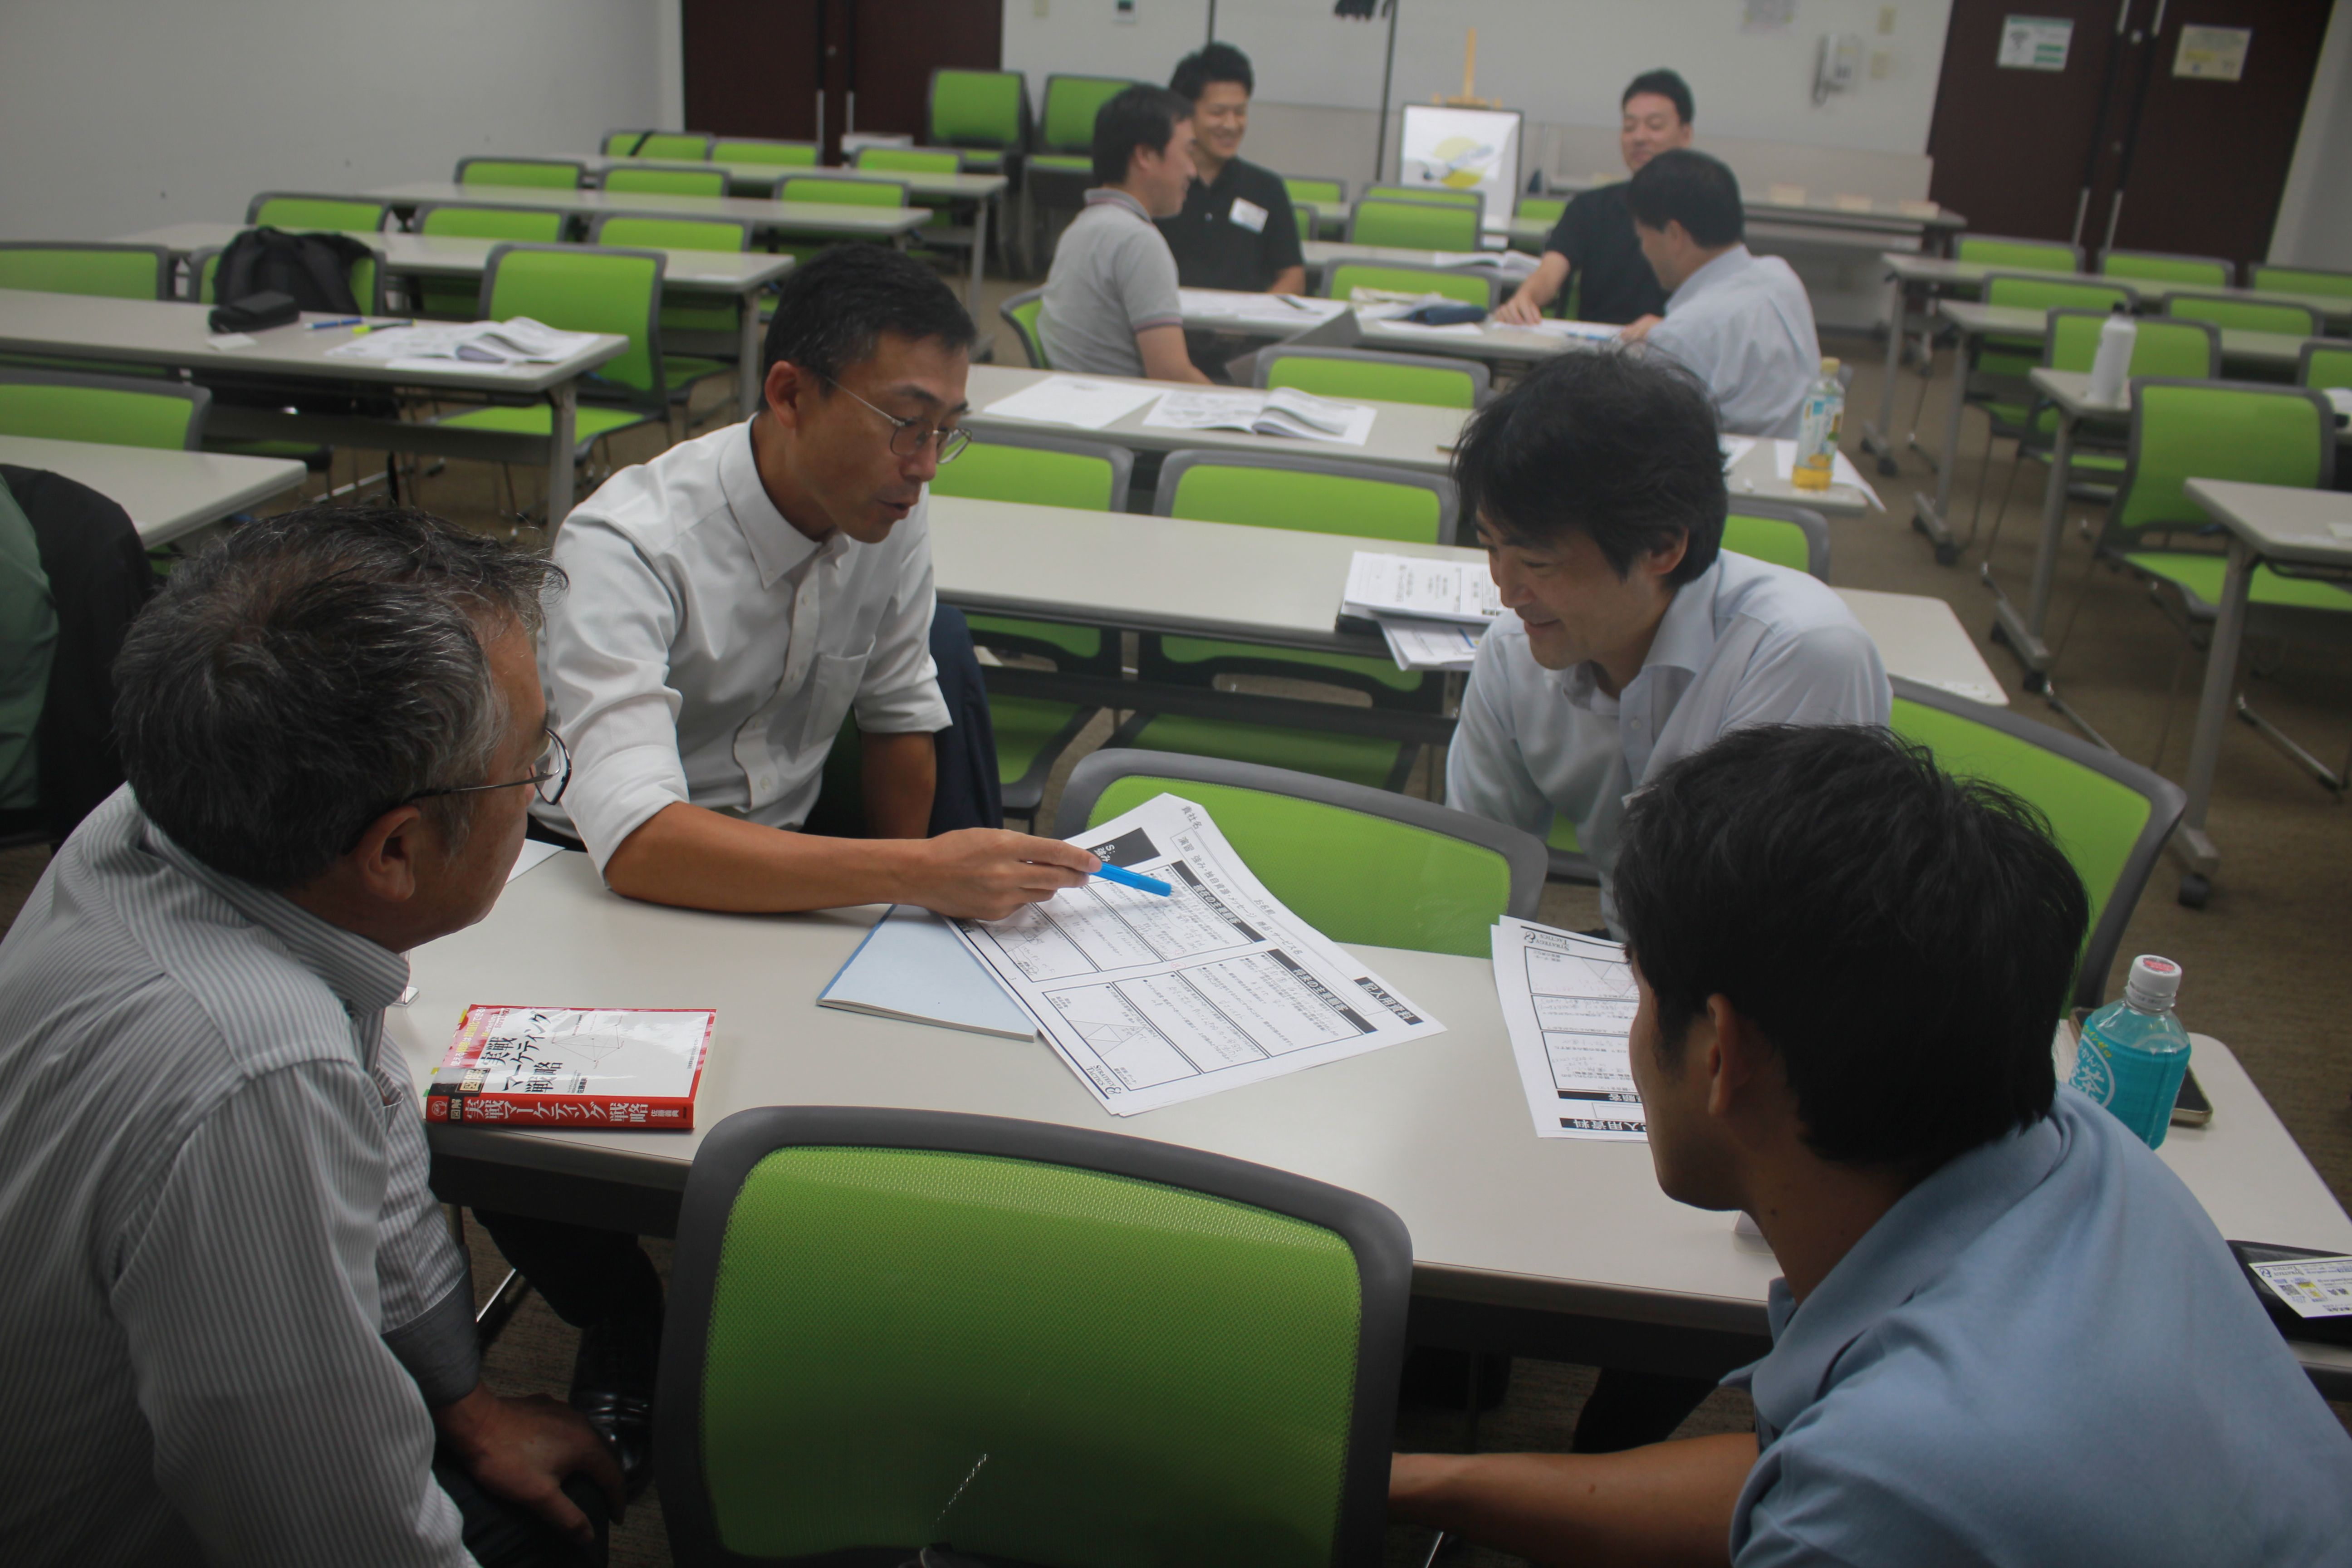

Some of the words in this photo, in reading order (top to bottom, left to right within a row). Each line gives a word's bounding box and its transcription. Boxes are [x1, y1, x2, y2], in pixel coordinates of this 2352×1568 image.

[1181, 806, 1202, 830] 貴社名
[1178, 836, 1195, 853] 演習
[1535, 938, 1569, 951] STRATEGY
[1539, 933, 1567, 944] TACTICS
[1293, 969, 1349, 1011] 将来の主要顧客
[1362, 982, 1415, 1019] 記入用資料
[481, 1014, 498, 1037] Marketing
[480, 1037, 518, 1065] 実戦
[502, 1010, 551, 1091] マーケティング
[459, 1069, 486, 1091] 図解
[525, 1062, 564, 1093] 戦略
[1086, 1066, 1105, 1086] TACTICS
[1093, 1064, 1116, 1087] STRATEGY
[451, 1098, 462, 1120] 図解
[465, 1099, 648, 1122] 実戦マーケティング戦略
